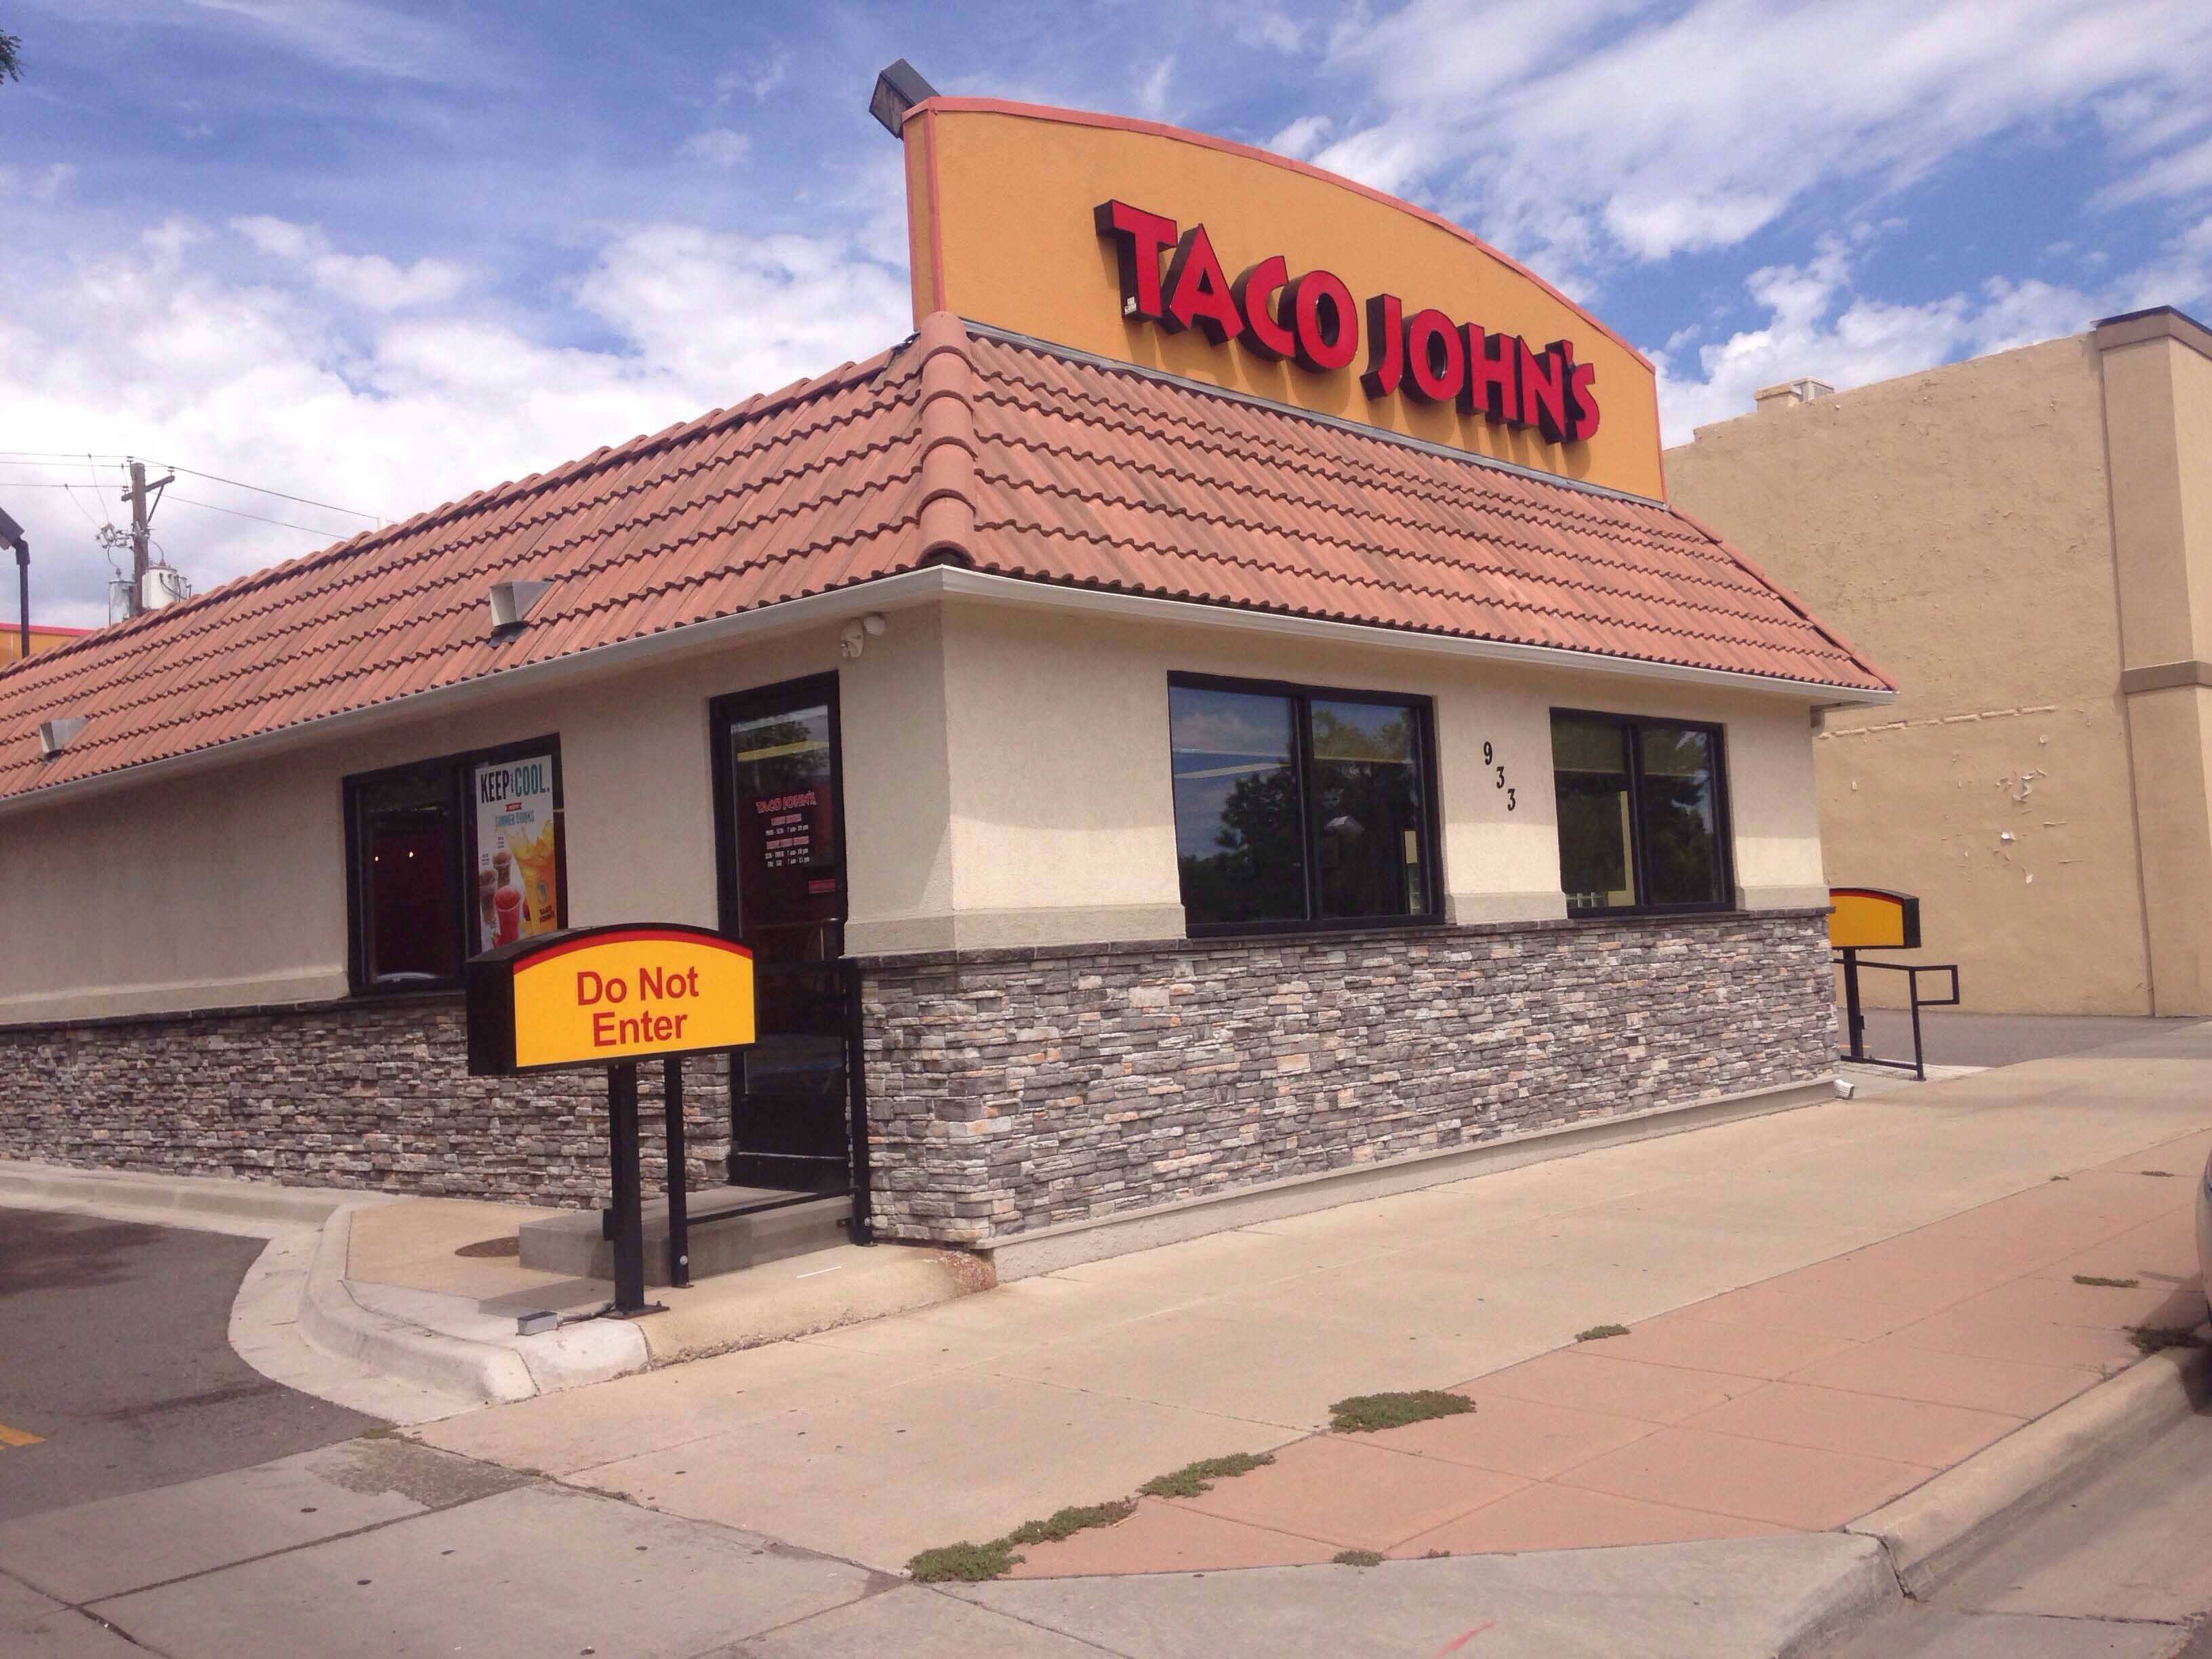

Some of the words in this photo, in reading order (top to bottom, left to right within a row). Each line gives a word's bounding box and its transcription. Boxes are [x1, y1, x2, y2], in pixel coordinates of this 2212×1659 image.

[1093, 199, 1358, 371] TACO
[1360, 293, 1601, 443] JOHN'S
[480, 770, 510, 804] KEEP
[756, 798, 781, 813] TACO
[577, 971, 627, 1006] Do
[639, 966, 699, 1001] Not
[593, 1010, 688, 1047] Enter
